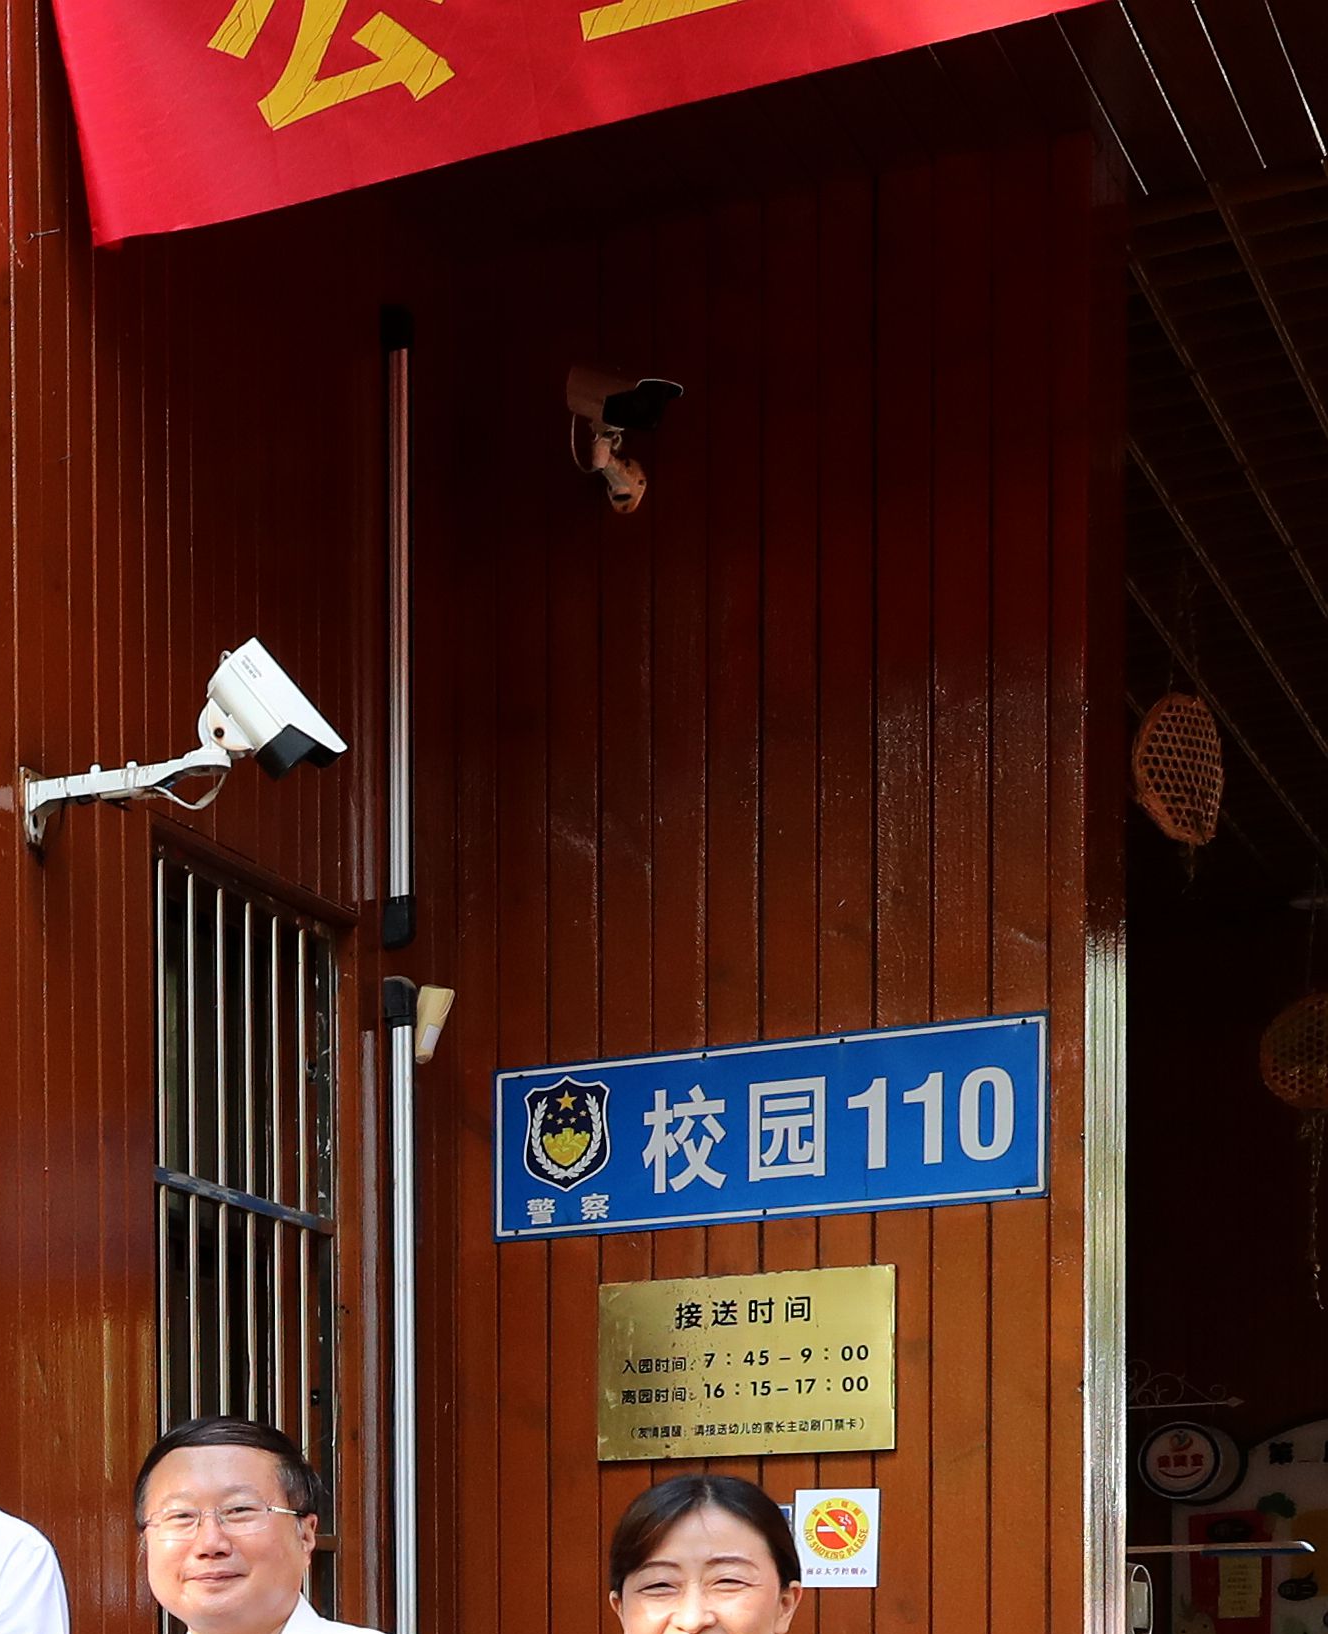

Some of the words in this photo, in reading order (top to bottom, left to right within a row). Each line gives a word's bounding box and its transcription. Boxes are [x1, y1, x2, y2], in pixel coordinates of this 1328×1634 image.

[642, 1066, 1015, 1194] 校园110
[527, 1193, 609, 1225] 警察
[675, 1296, 812, 1330] 接送时间
